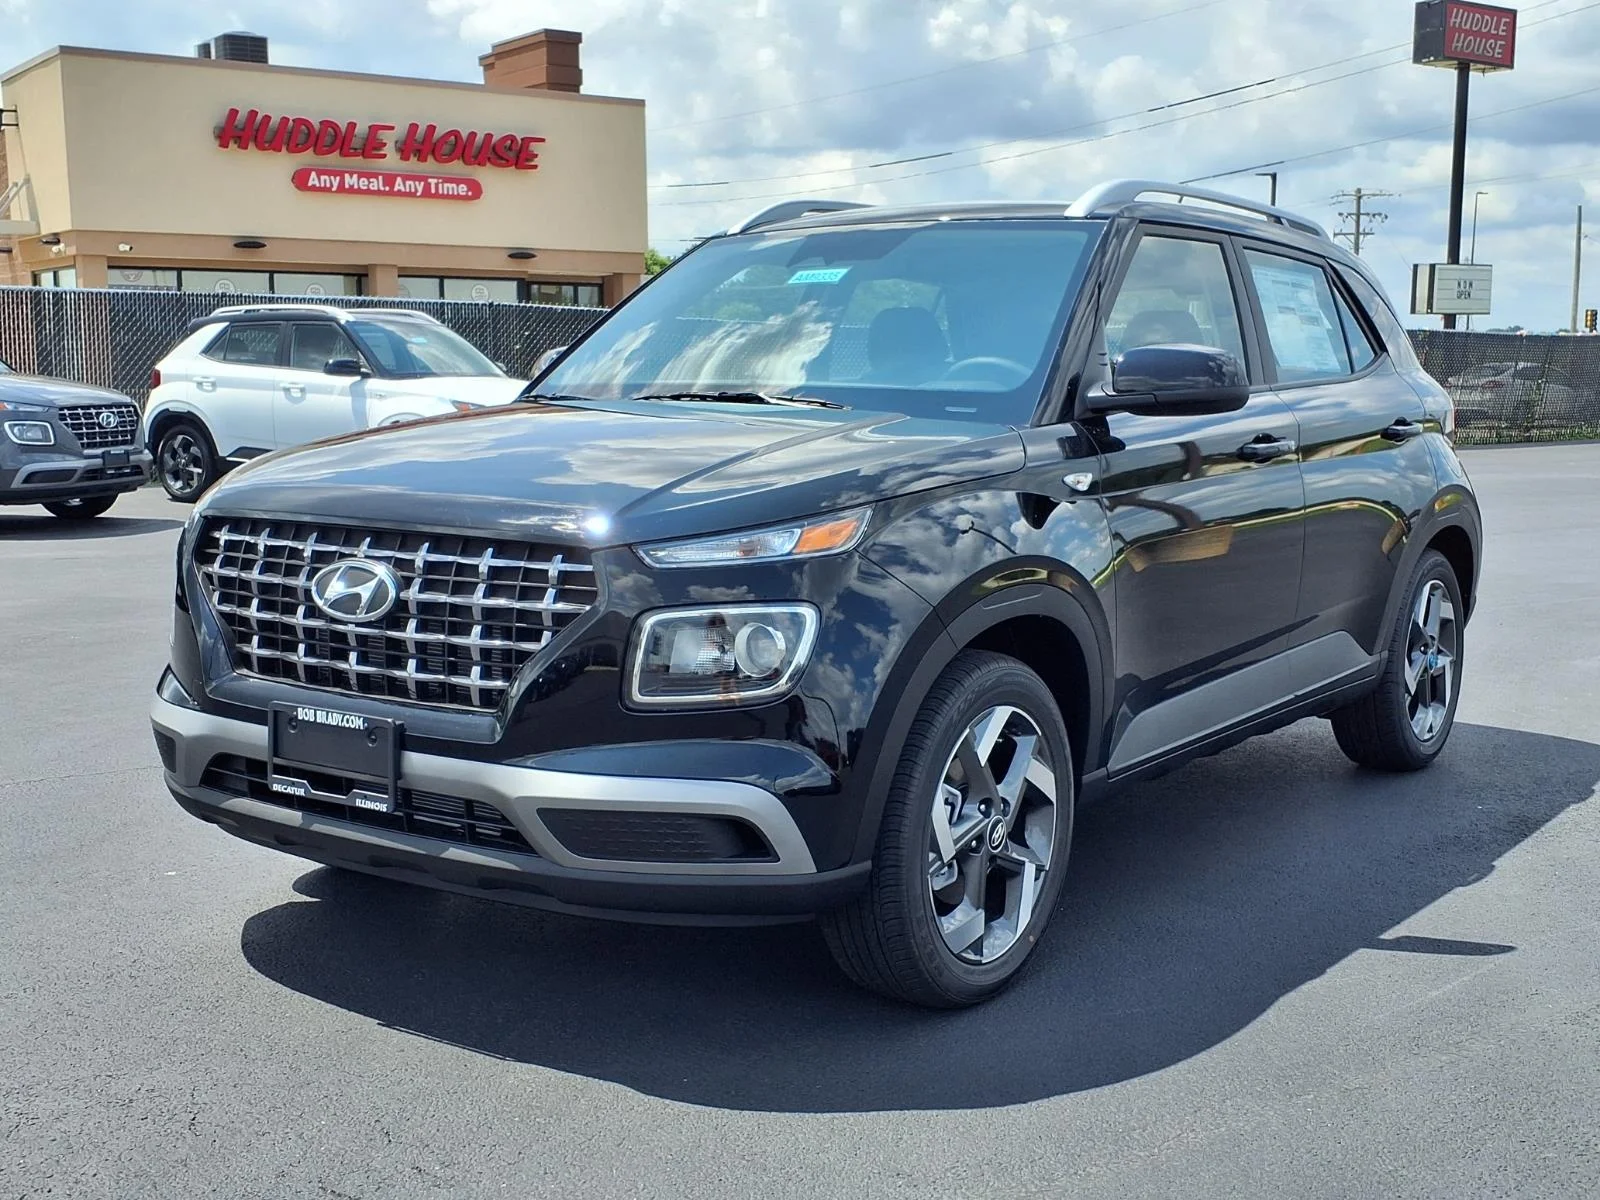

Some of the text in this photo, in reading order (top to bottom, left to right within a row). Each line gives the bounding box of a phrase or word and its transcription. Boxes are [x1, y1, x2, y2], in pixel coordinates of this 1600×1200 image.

[1450, 7, 1510, 36] HUDDLE
[1452, 32, 1506, 58] HOUSE
[217, 107, 546, 170] HUDDLE HOUSE
[307, 171, 473, 196] Any Meal. Any Time.
[1456, 290, 1471, 300] OPEN
[297, 707, 315, 721] BOB
[272, 783, 306, 797] DECATUR
[355, 798, 388, 812] ILLINOIS
